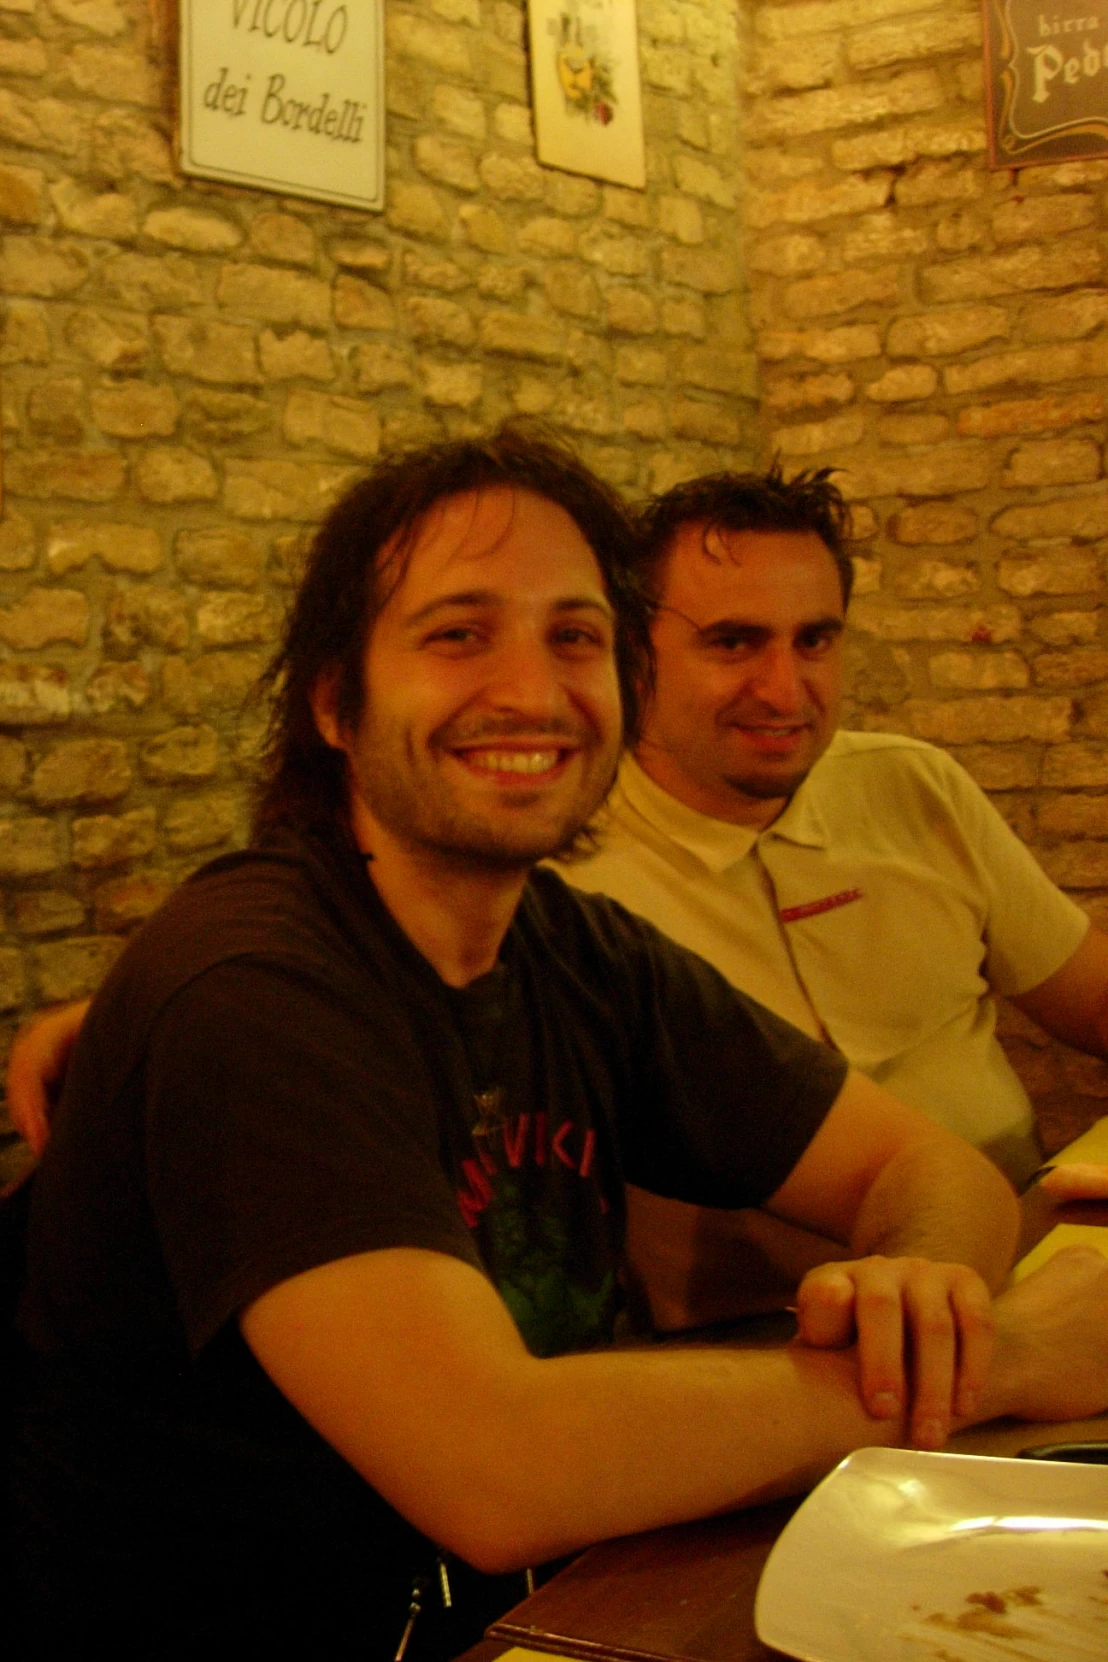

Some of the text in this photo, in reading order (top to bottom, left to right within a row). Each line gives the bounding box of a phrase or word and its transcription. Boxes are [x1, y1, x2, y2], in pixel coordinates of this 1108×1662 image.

[1038, 14, 1099, 36] birra
[203, 66, 368, 144] dei Bordelli
